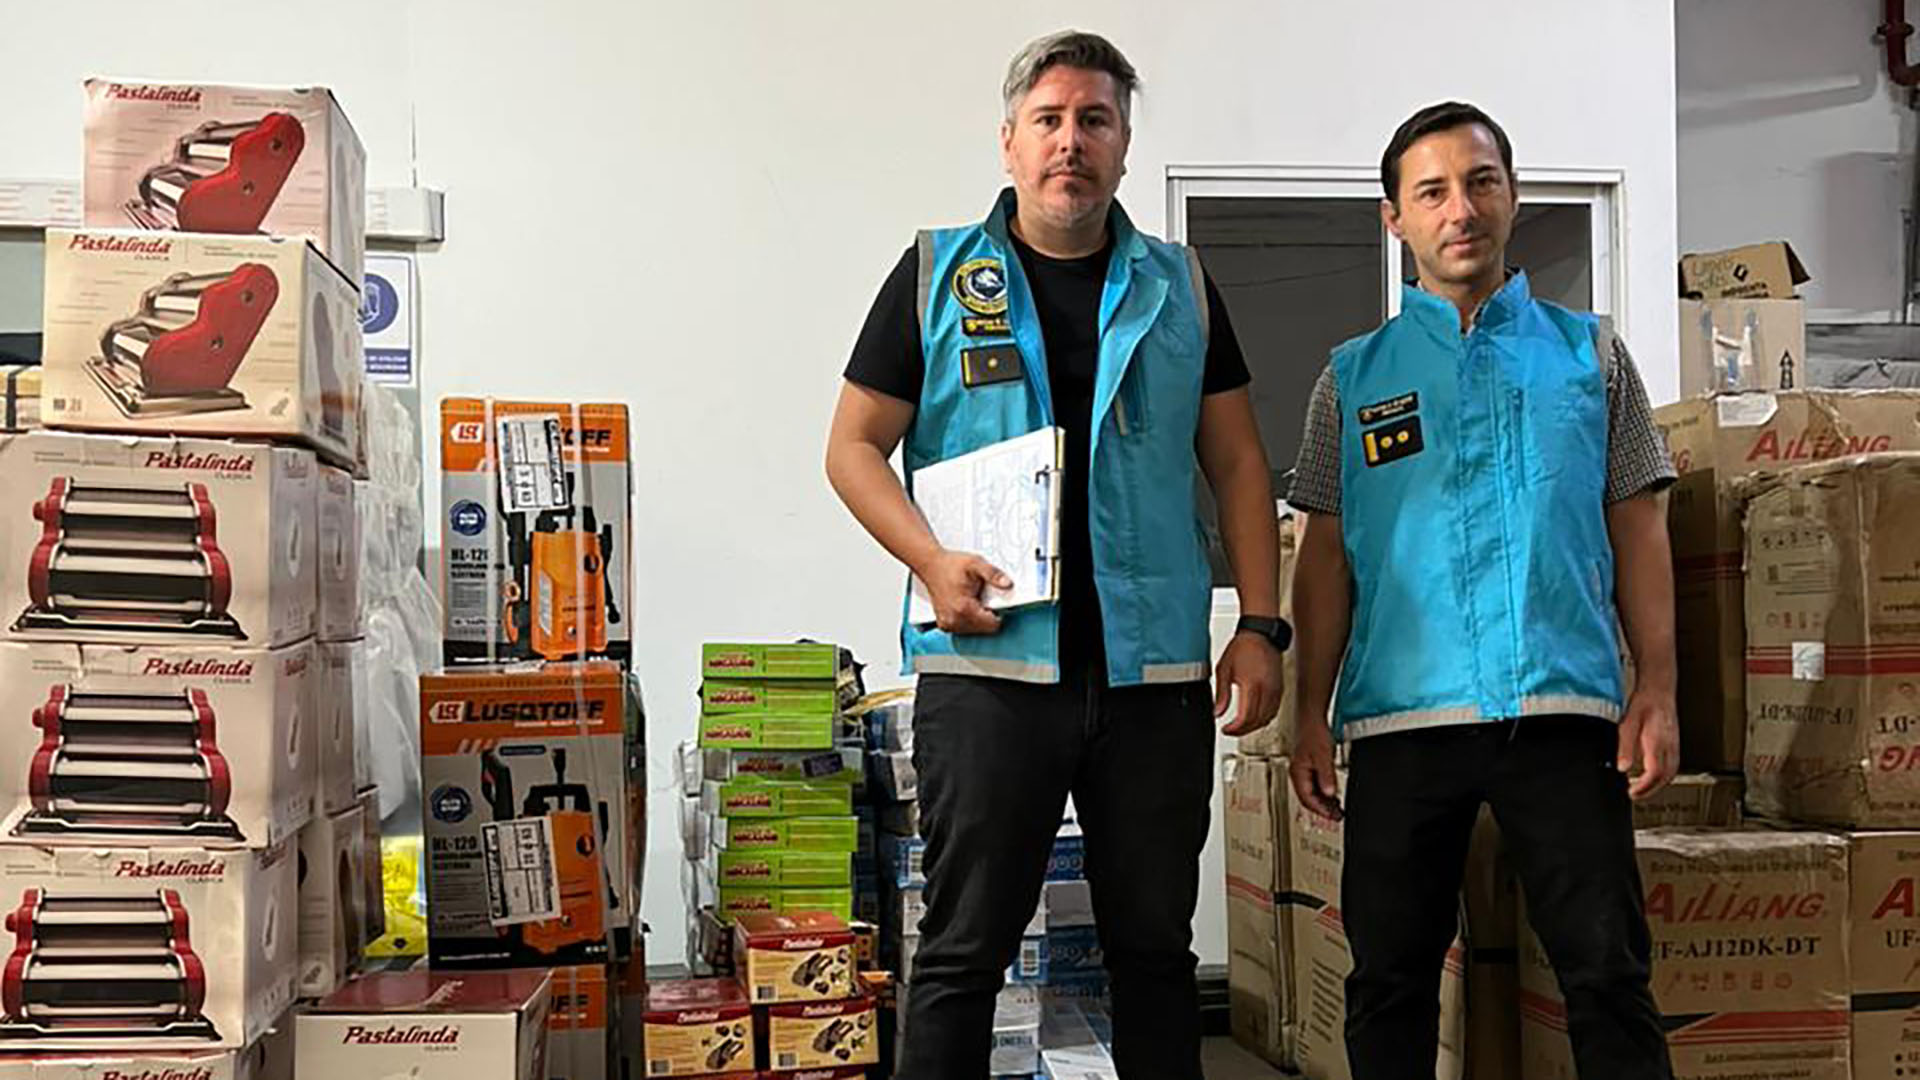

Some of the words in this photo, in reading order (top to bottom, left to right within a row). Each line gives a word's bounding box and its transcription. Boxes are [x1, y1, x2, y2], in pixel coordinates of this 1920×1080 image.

[105, 83, 202, 102] Pastalinda
[68, 234, 172, 254] Pastalinda
[144, 451, 254, 471] Pastalinda
[143, 658, 253, 676] Pastalinda
[115, 859, 225, 877] Pastalinda
[342, 1024, 460, 1044] Pastalinda
